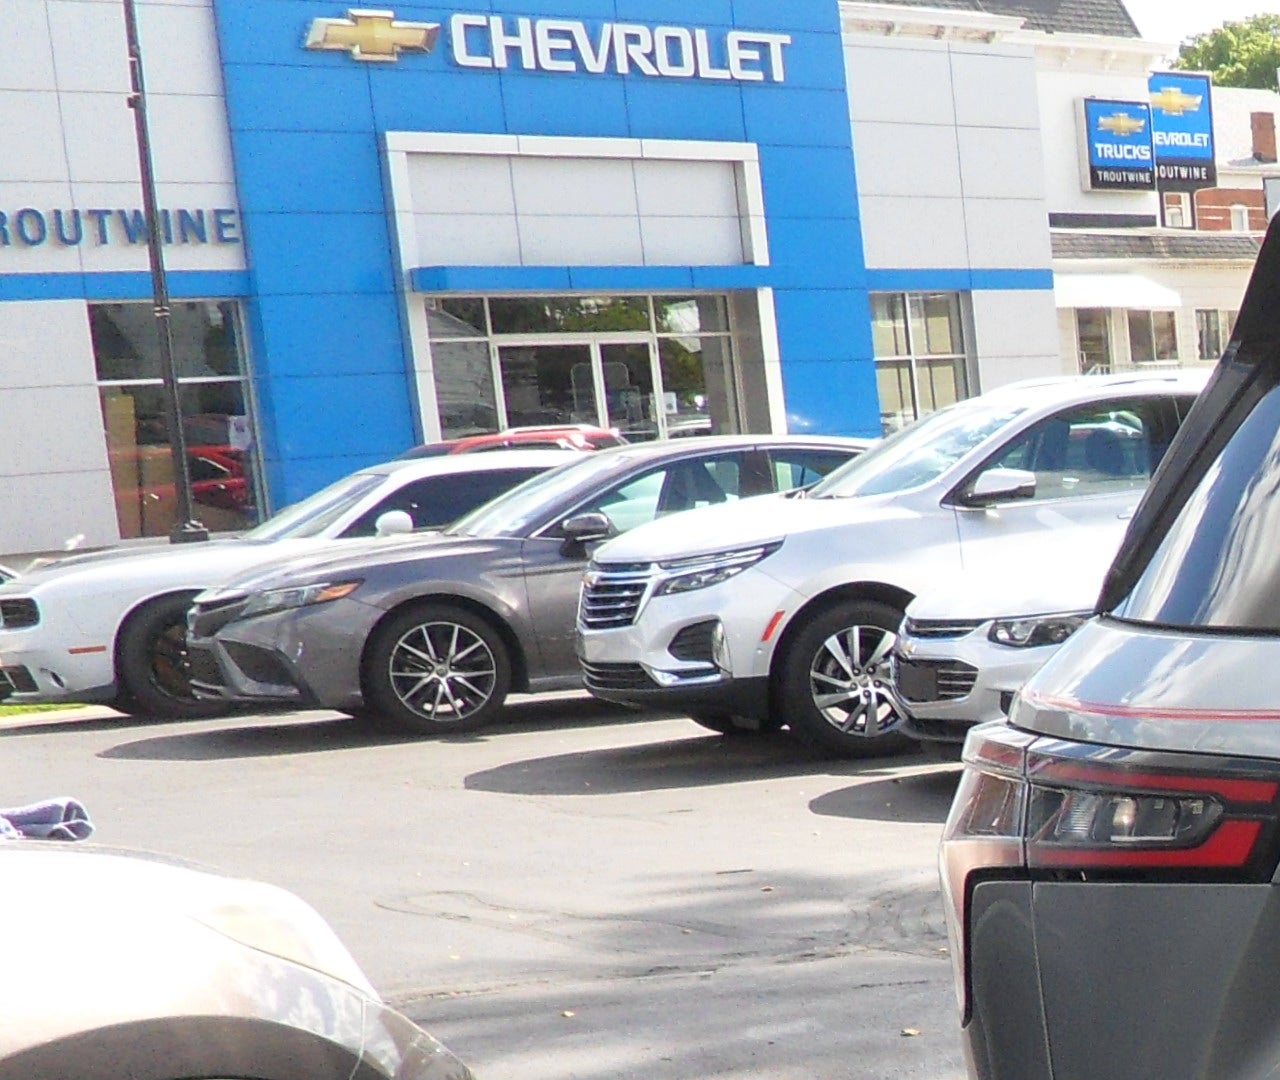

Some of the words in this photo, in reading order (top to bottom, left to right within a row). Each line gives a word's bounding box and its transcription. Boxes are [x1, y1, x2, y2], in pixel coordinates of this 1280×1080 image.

[451, 13, 792, 83] CHEVROLET
[1095, 142, 1151, 160] TRUCKS
[1097, 170, 1152, 183] TROUTWINE
